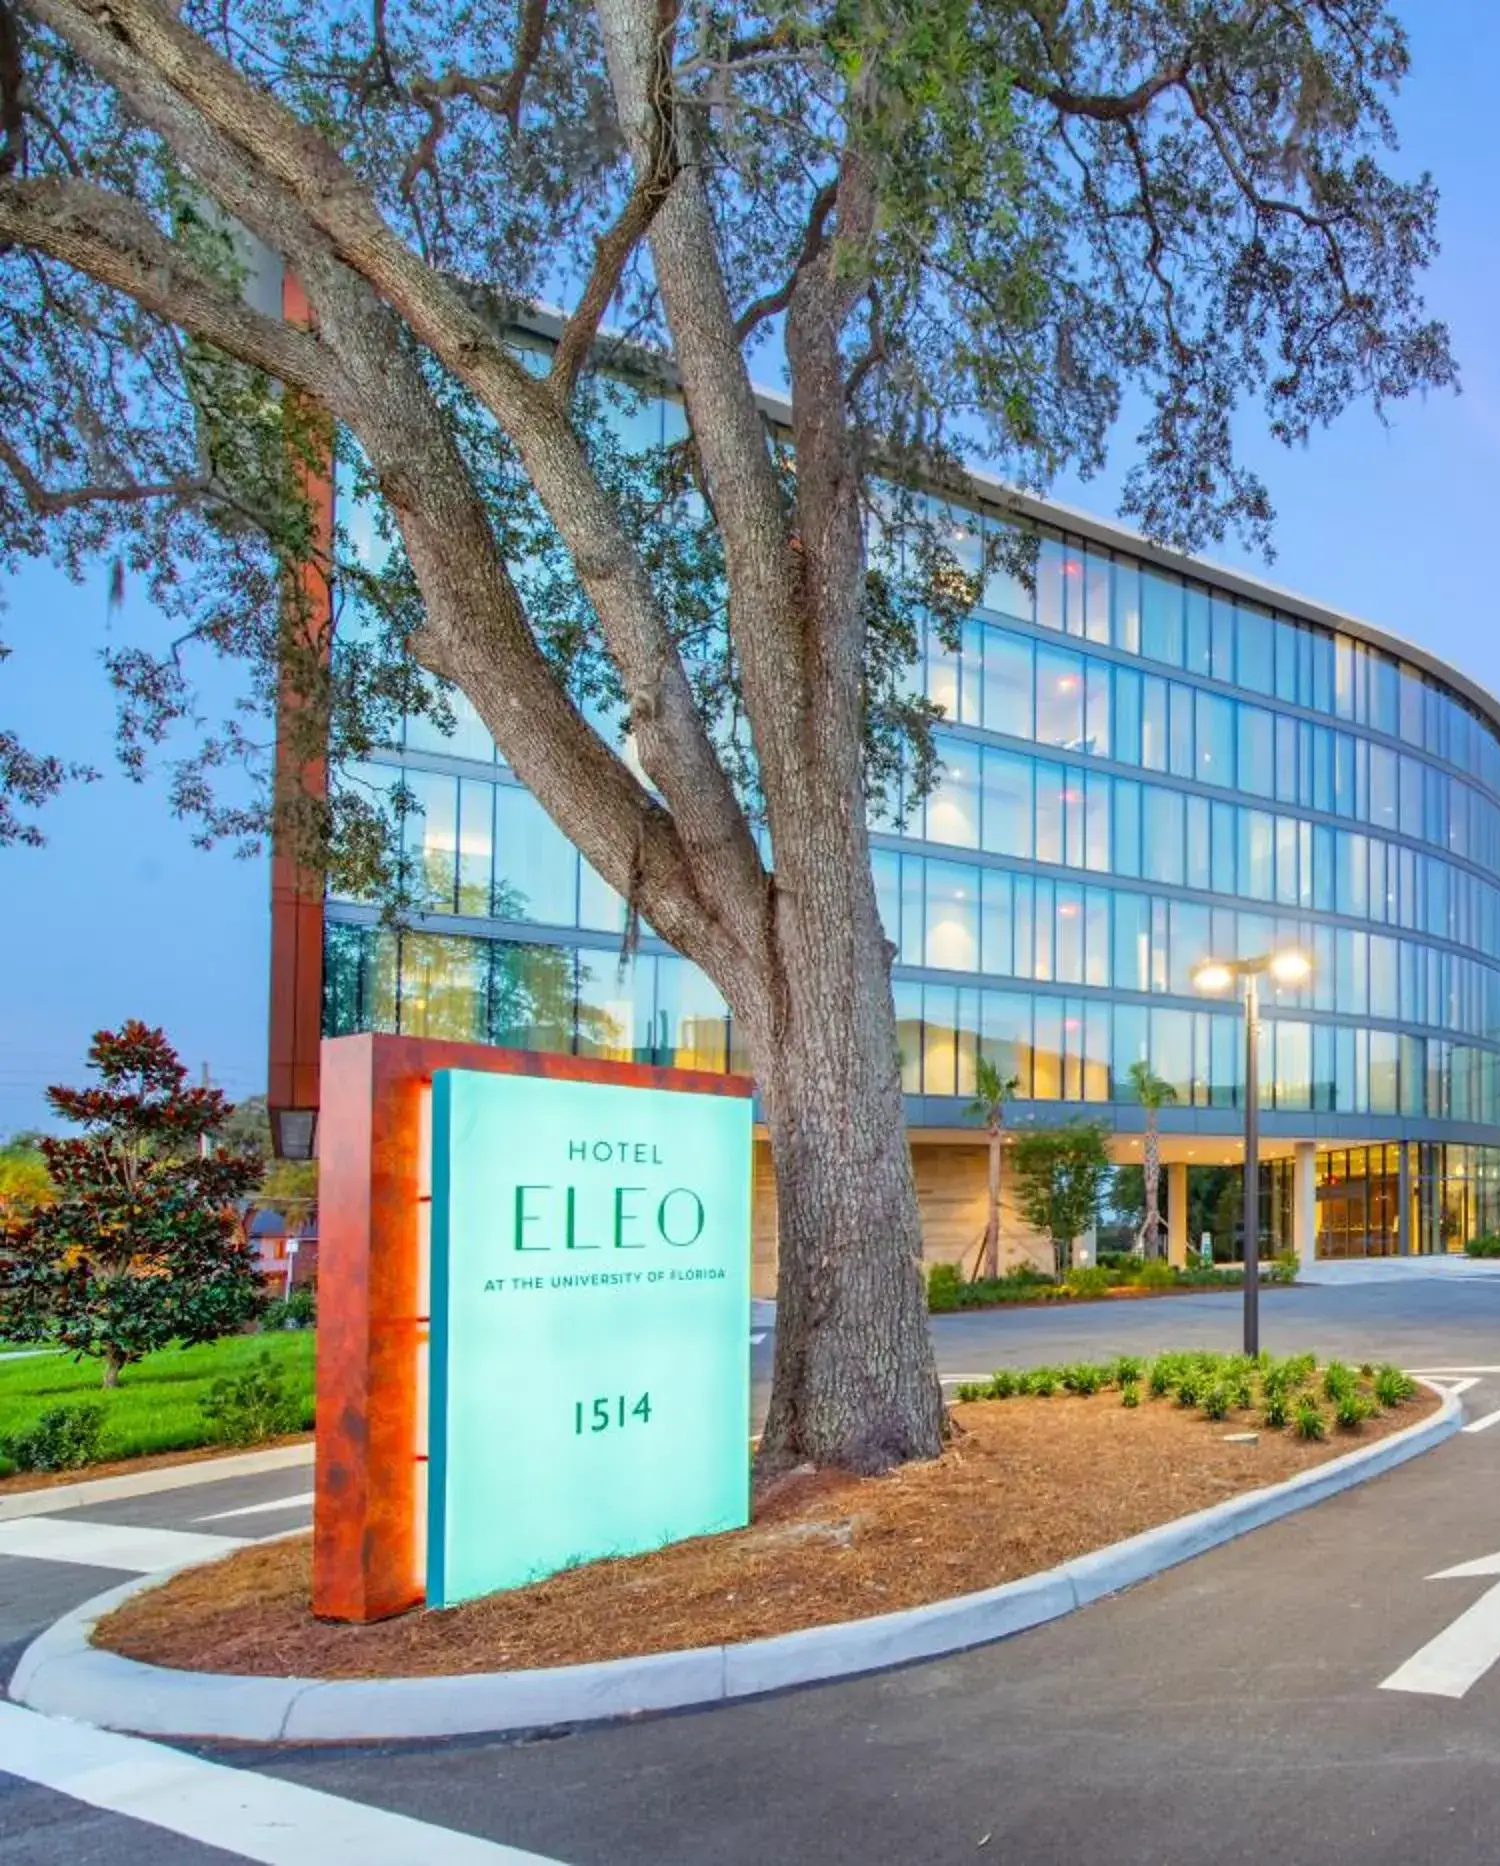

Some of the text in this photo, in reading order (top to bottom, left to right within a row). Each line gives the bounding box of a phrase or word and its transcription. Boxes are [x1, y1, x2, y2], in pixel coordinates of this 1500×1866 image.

[569, 1140, 662, 1164] HOTEL
[514, 1185, 705, 1251] ELEO
[484, 1269, 726, 1292] AT THE UNIVERSITY OF FLORIDA
[575, 1391, 652, 1434] 1514
